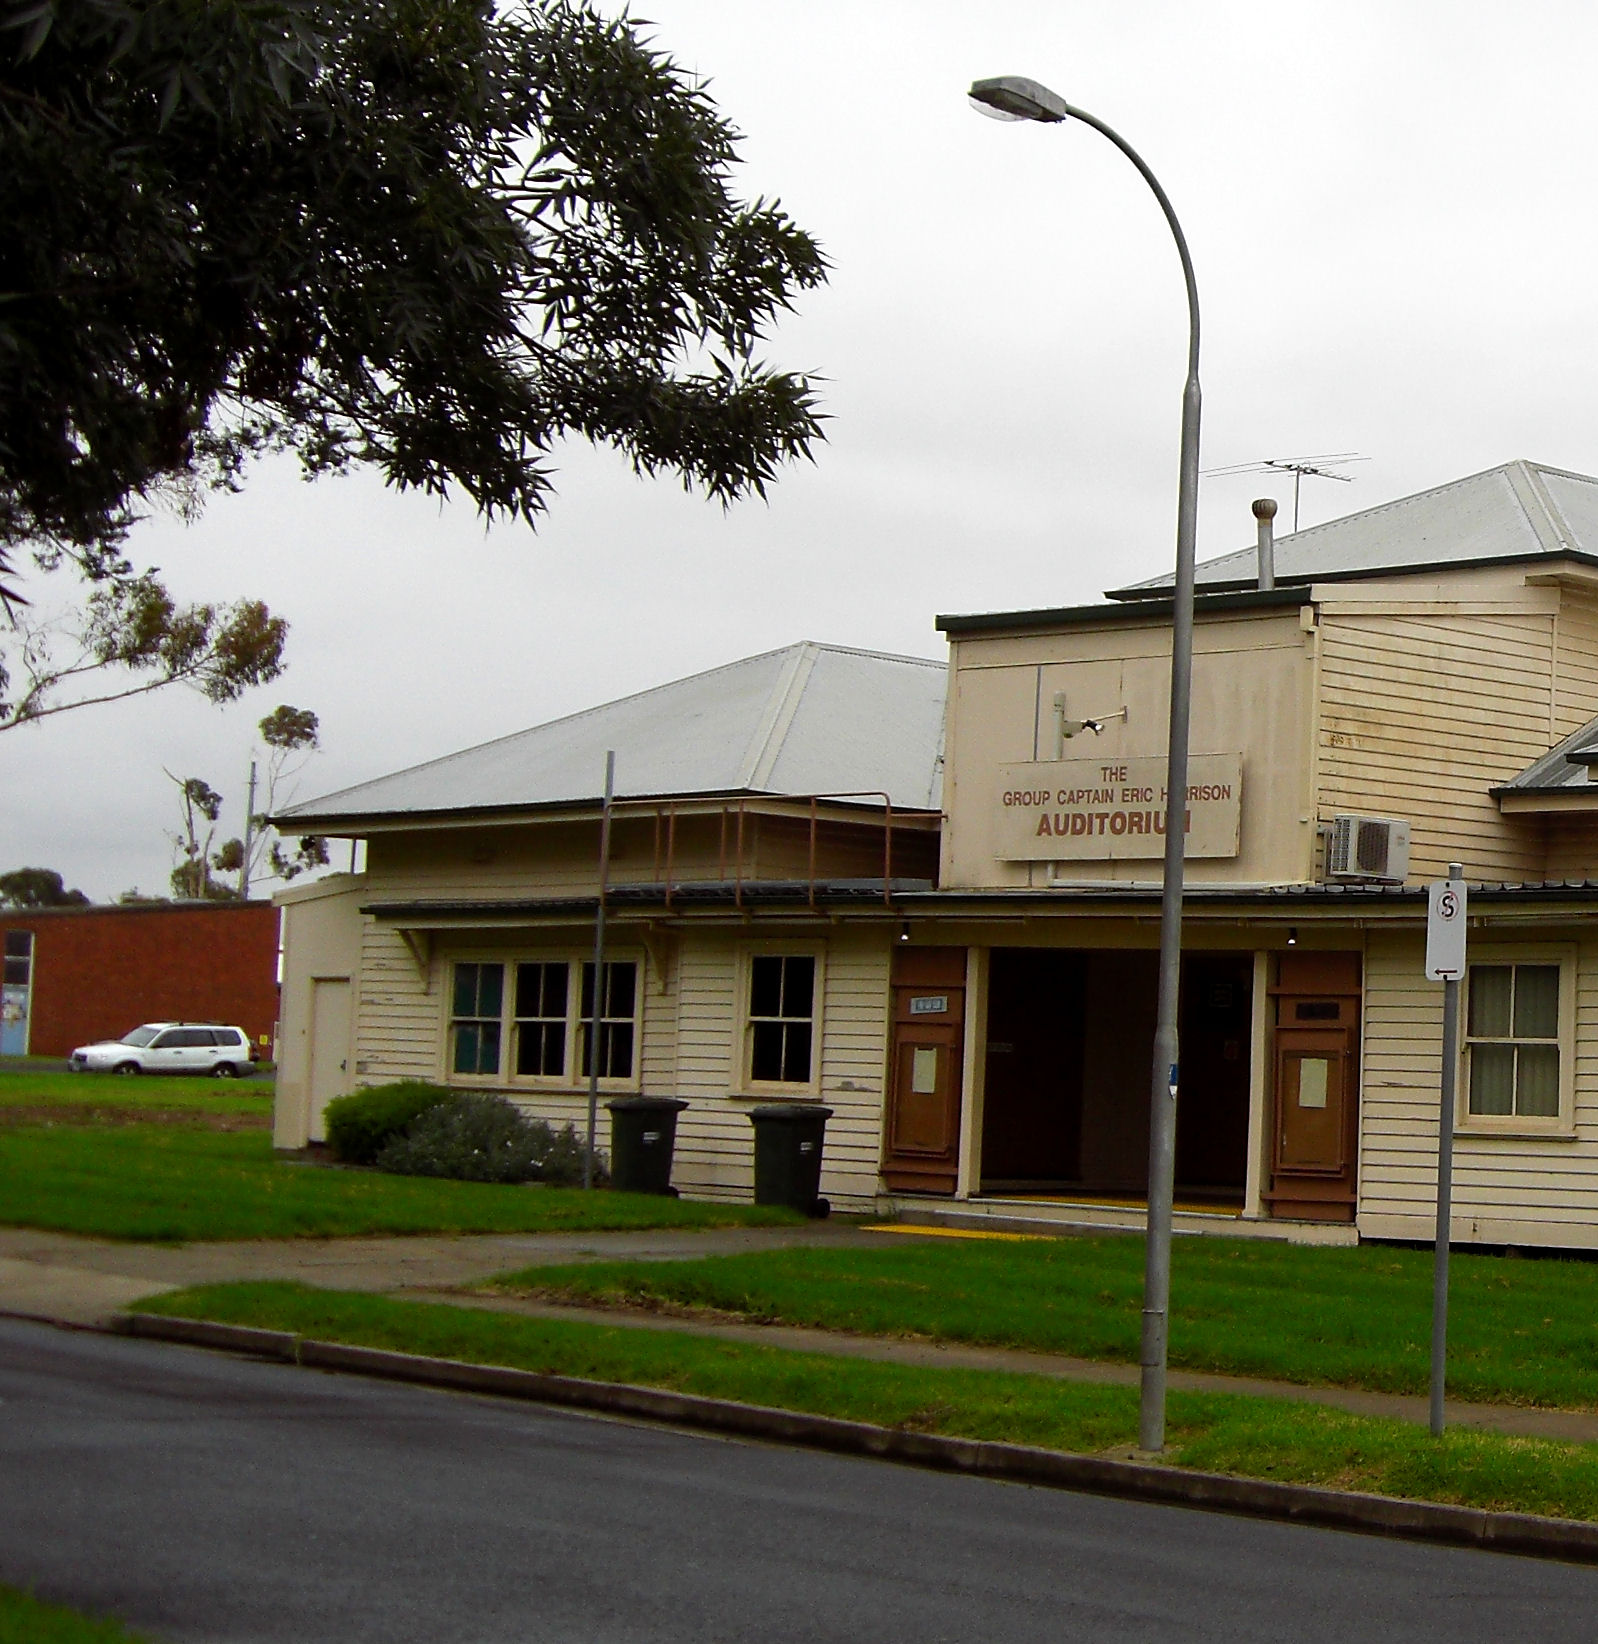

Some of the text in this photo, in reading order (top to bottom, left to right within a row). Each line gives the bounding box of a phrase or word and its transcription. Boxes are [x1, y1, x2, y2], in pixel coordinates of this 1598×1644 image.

[1101, 766, 1127, 782] THE
[1003, 784, 1231, 806] GROUP CAPTAIN ERIC HRISON
[1442, 895, 1454, 918] S
